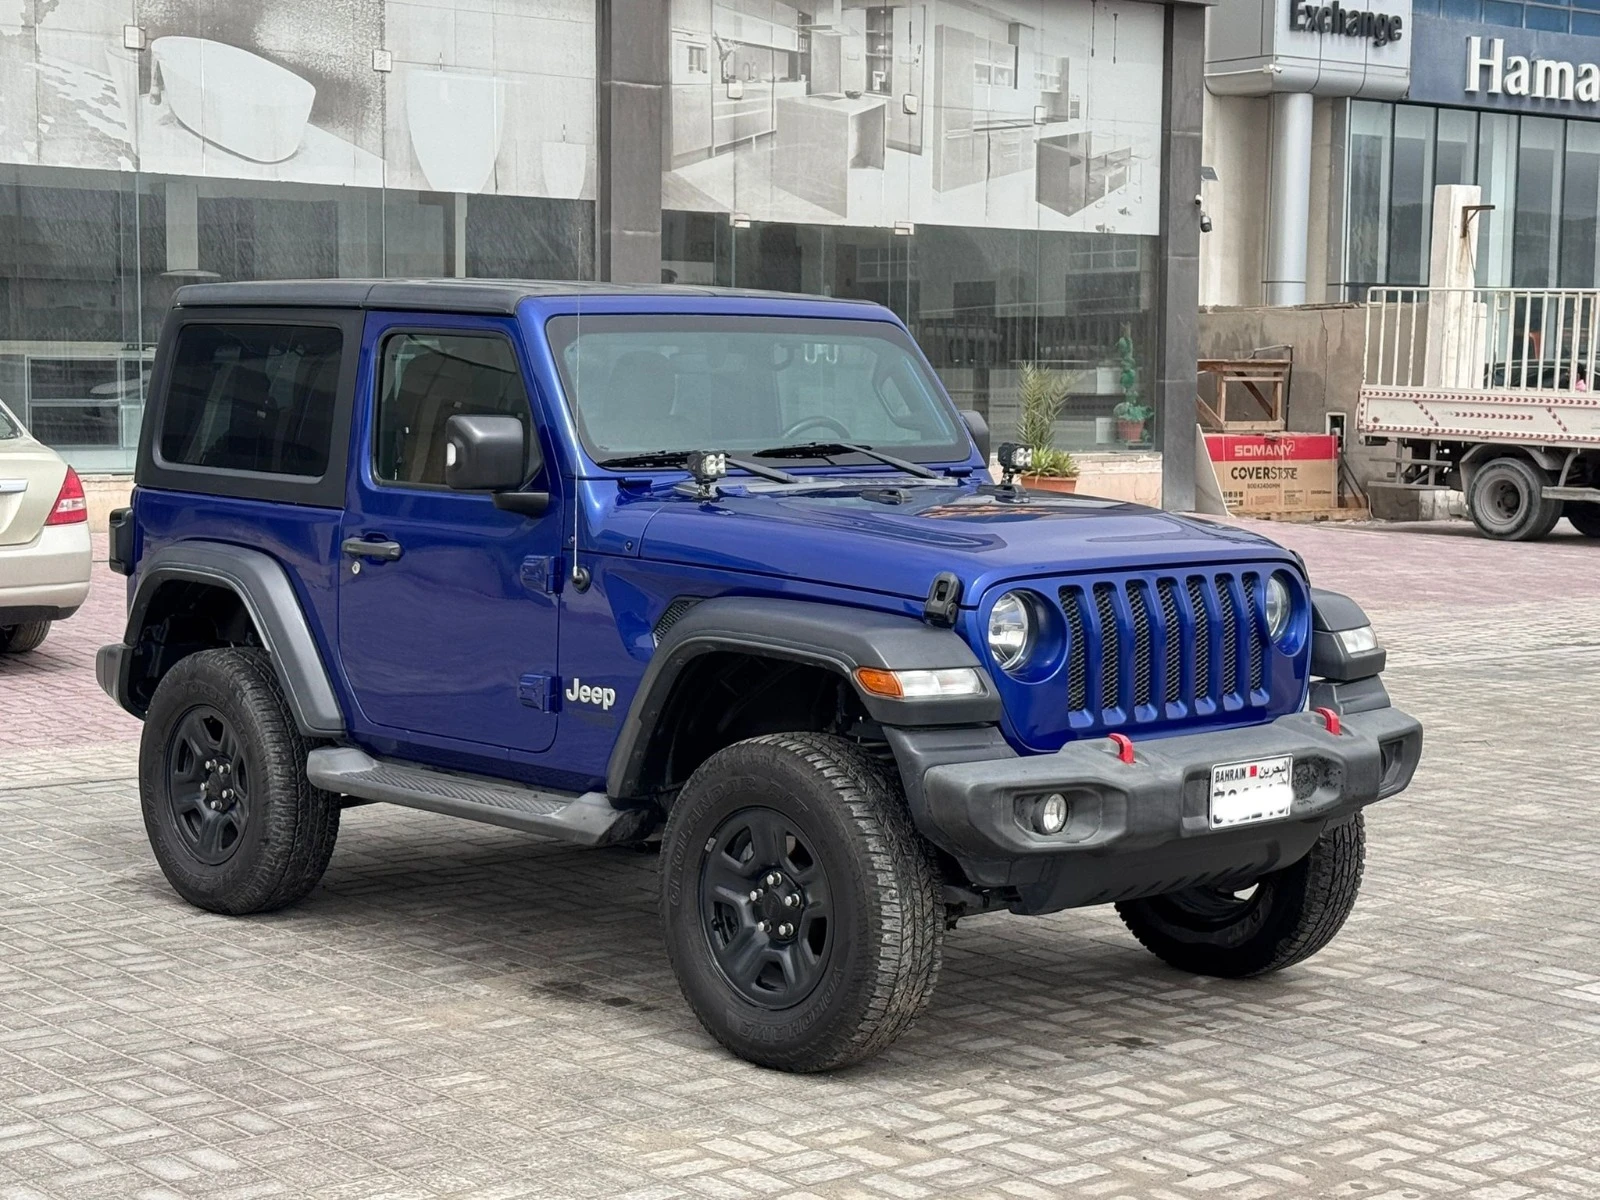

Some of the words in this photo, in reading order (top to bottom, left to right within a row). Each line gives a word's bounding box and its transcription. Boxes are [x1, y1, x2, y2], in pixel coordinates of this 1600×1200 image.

[1289, 0, 1402, 47] Exchange
[1234, 444, 1293, 457] SOMANY
[1231, 466, 1297, 480] COVERSTONE
[565, 677, 616, 710] Jeep
[1214, 766, 1247, 783] BAHRAIN
